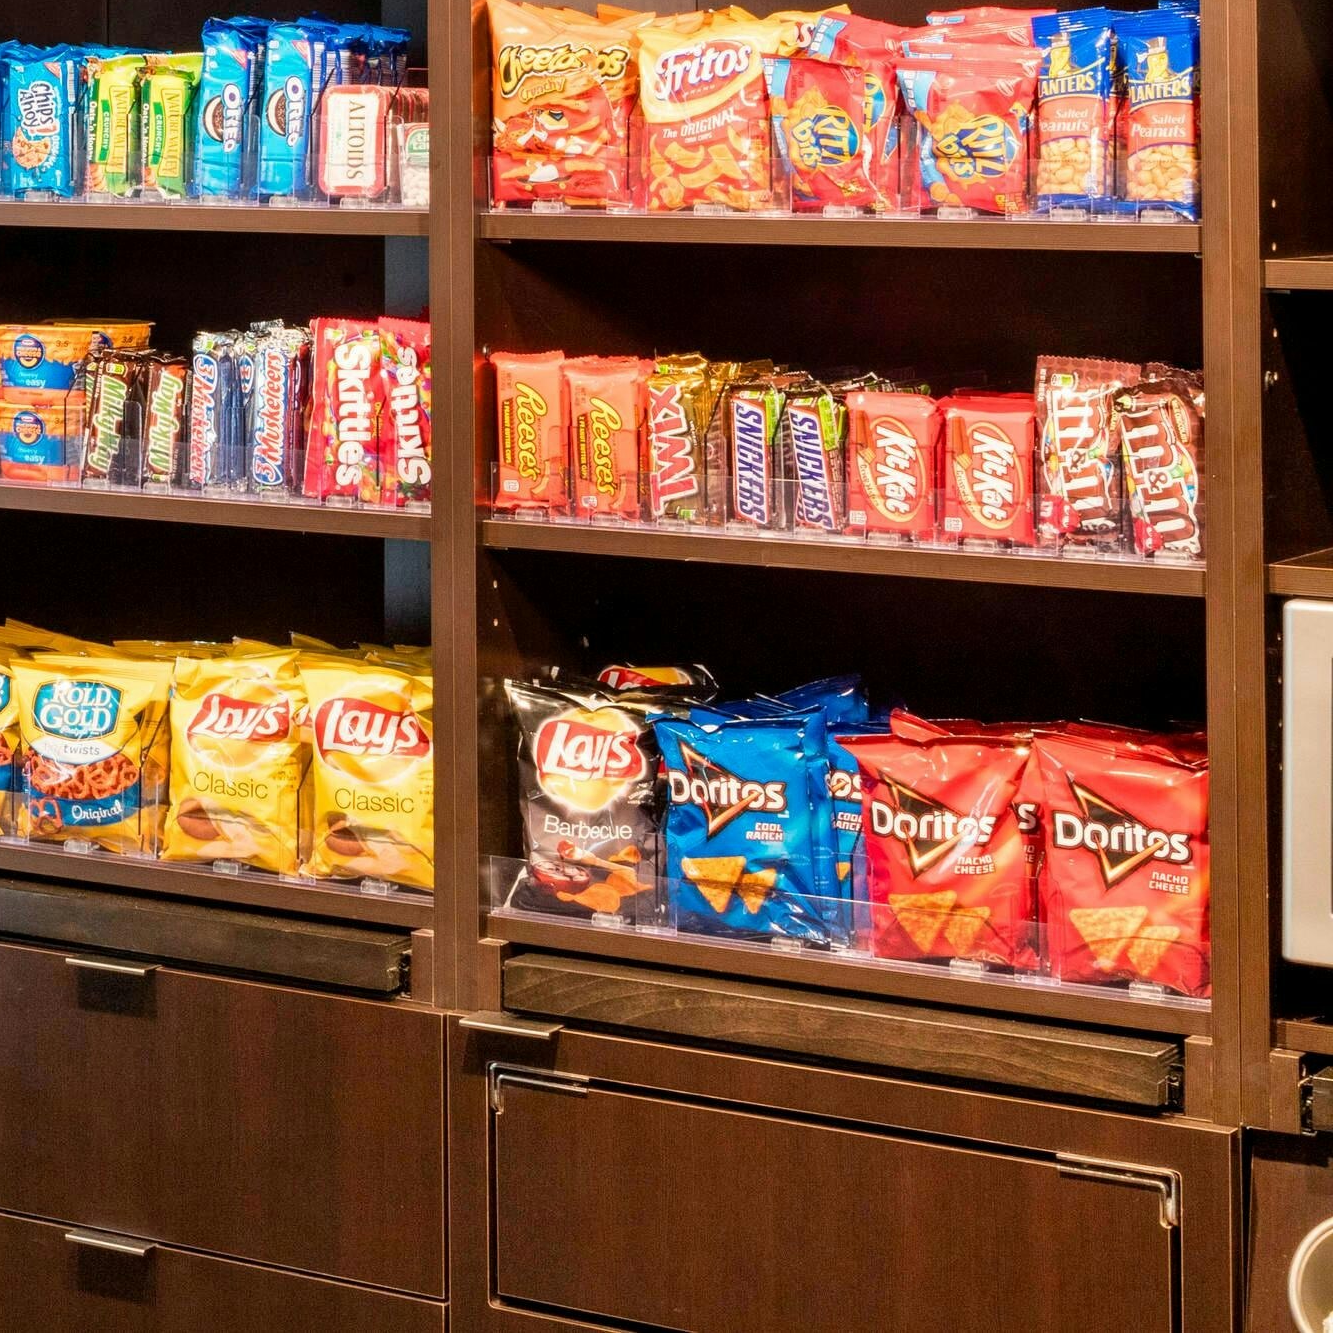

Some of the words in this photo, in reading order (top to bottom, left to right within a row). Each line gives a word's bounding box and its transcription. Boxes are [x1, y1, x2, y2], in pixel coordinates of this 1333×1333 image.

[654, 41, 752, 101] Fritos
[30, 82, 55, 126] Chips
[519, 76, 566, 103] Crunchy
[221, 83, 242, 153] OREO
[284, 76, 306, 147] OREO
[1040, 120, 1089, 133] eanuts
[1055, 108, 1089, 119] Salted
[1152, 114, 1186, 125] Salted
[155, 114, 163, 153] CRUNCHY
[346, 100, 367, 180] ALTOIDS
[662, 128, 678, 139] The
[813, 106, 852, 164] RITZ
[961, 116, 1007, 176] RITZ
[1130, 123, 1187, 139] Peanuts
[25, 378, 46, 389] easy
[254, 351, 284, 463] Musketeers
[334, 344, 372, 486] Skittles
[391, 346, 431, 486] Skittles
[515, 382, 549, 482] Reese's
[590, 397, 623, 497] Reese's
[24, 454, 45, 464] easy
[648, 385, 699, 516] TWIX
[735, 403, 766, 523] SNICKERS
[254, 458, 275, 481] 3
[789, 412, 834, 530] SNICKERS
[52, 682, 112, 707] ROLD
[39, 703, 112, 733] GOLD
[196, 694, 287, 740] Lay's
[323, 699, 420, 756] Lay's
[63, 743, 101, 756] twists
[542, 722, 634, 783] Lay's
[193, 770, 269, 799] Classic
[334, 787, 415, 814] Classic
[668, 769, 787, 810] Doritos
[71, 800, 124, 823] Original
[543, 814, 633, 840] Barbecue
[754, 822, 783, 832] COOL
[870, 800, 997, 844] Doritos
[745, 830, 784, 841] RANCH
[1054, 812, 1191, 862] Doritos
[954, 864, 996, 875] CHEESE
[956, 854, 992, 866] NACHO
[1148, 880, 1190, 895] CHEESE
[1152, 871, 1190, 885] NACHO
